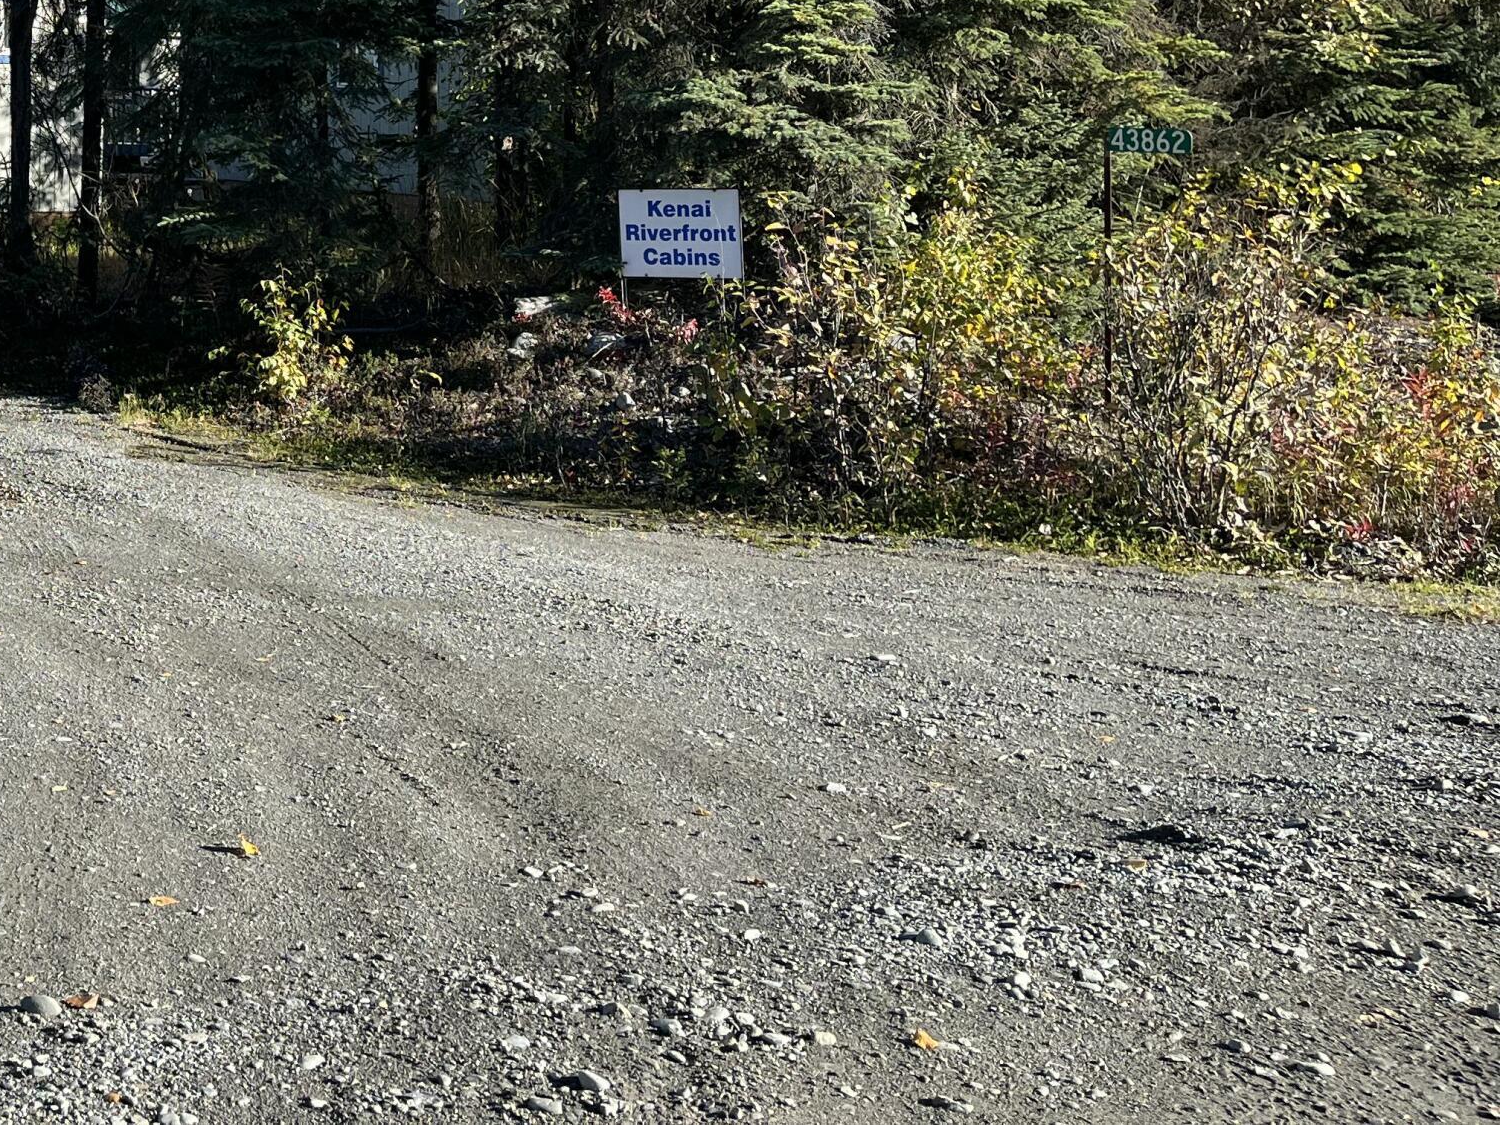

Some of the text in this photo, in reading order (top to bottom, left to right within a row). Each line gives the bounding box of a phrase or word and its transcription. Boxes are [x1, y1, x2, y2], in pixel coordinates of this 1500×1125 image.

[1110, 128, 1186, 154] 43862
[647, 200, 711, 217] Kenai
[625, 224, 737, 242] Riverfront
[643, 248, 721, 266] Cabins
